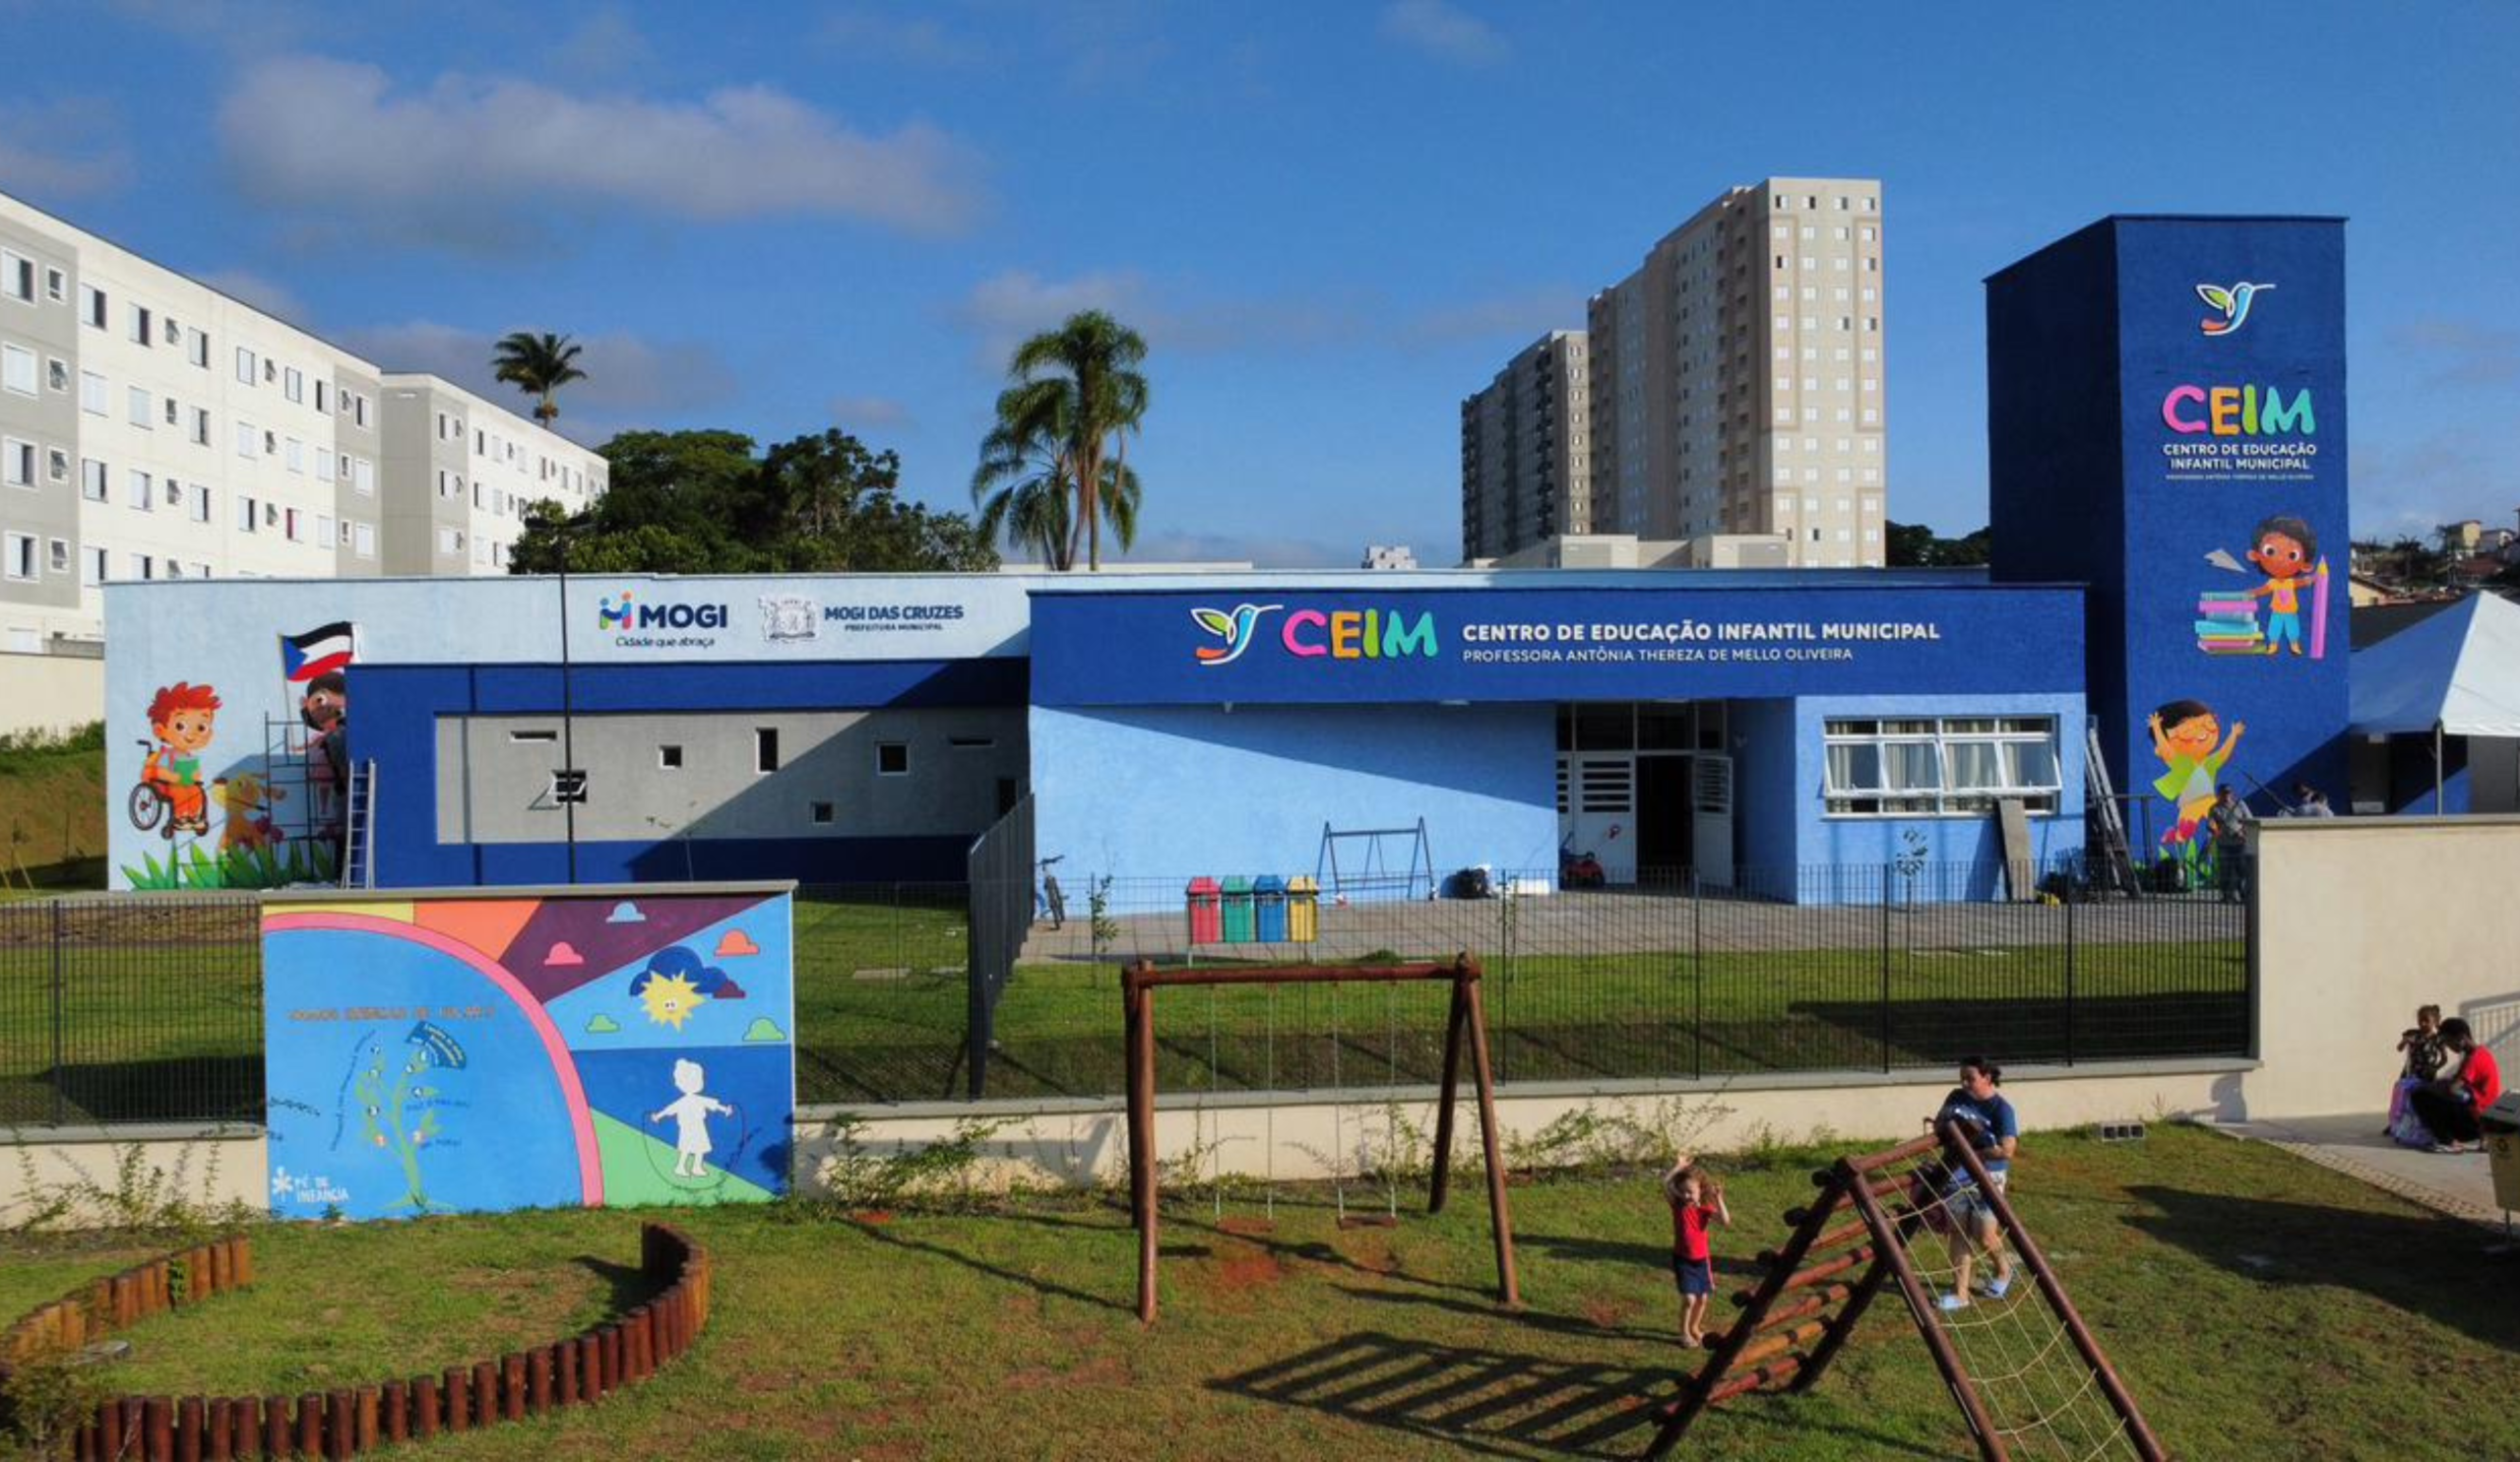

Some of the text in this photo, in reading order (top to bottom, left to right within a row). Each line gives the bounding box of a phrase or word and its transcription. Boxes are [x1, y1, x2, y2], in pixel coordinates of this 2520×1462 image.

[2163, 383, 2315, 435] CEIM
[2163, 442, 2317, 457] CENTRO DE EDUCAÇÃO
[2171, 458, 2310, 470] INFANTIL MUNICIPAL
[639, 604, 727, 629] MOGI
[824, 604, 964, 620] MOGI DAS CRUZES
[845, 623, 896, 632] PREFEITURA
[1283, 608, 1439, 659] CEIM
[1463, 619, 1940, 644] CENTRO DE EDUCAÇÃO INFANTIL MUNICIPAL
[615, 635, 716, 649] Cidade que abraça
[1463, 646, 1854, 663] PROFESSORA ANTÔNIA THEREZA DE MELLO OLIVEIRA
